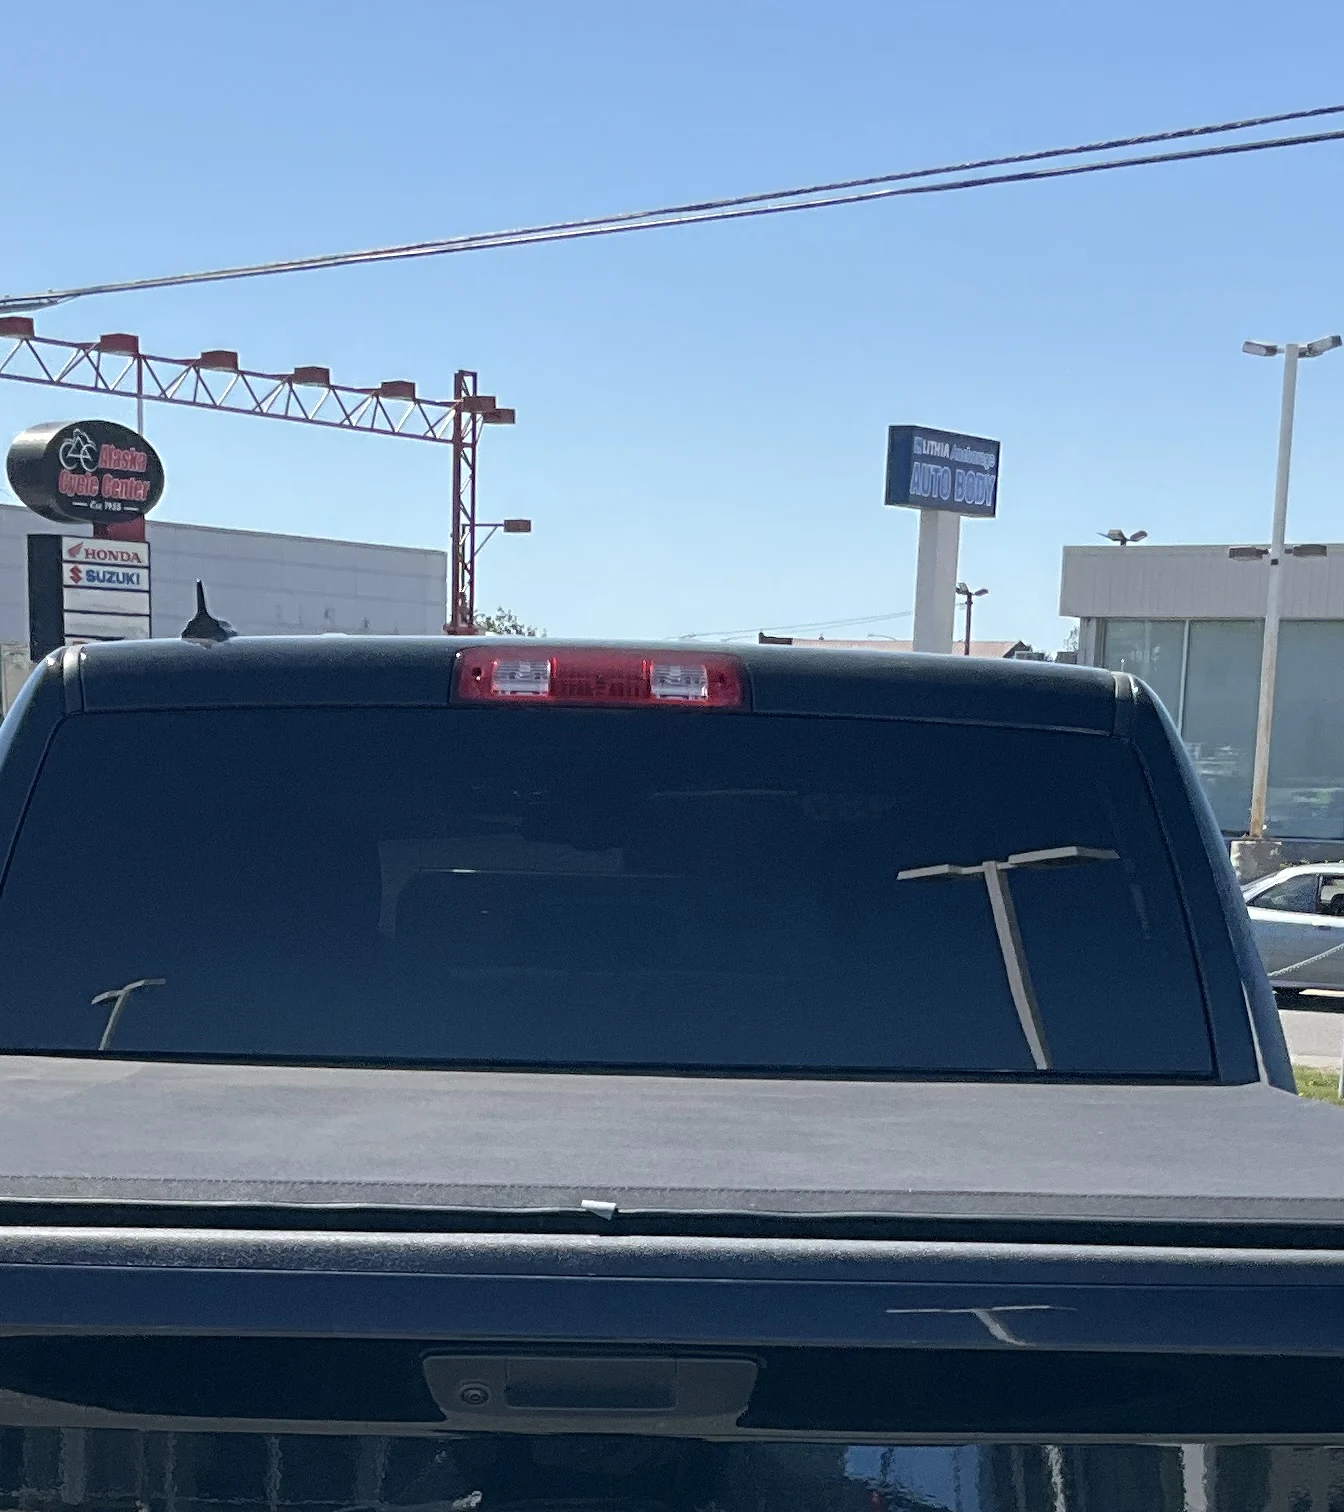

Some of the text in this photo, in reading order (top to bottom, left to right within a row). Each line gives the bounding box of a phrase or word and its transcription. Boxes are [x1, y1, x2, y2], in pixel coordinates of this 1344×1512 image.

[98, 444, 148, 473] Alaska
[922, 439, 950, 459] LITHIA
[58, 469, 151, 501] Cycle Center
[909, 461, 996, 507] AUTO BODY
[84, 547, 142, 564] HONDA
[85, 569, 141, 586] SUZUKI
